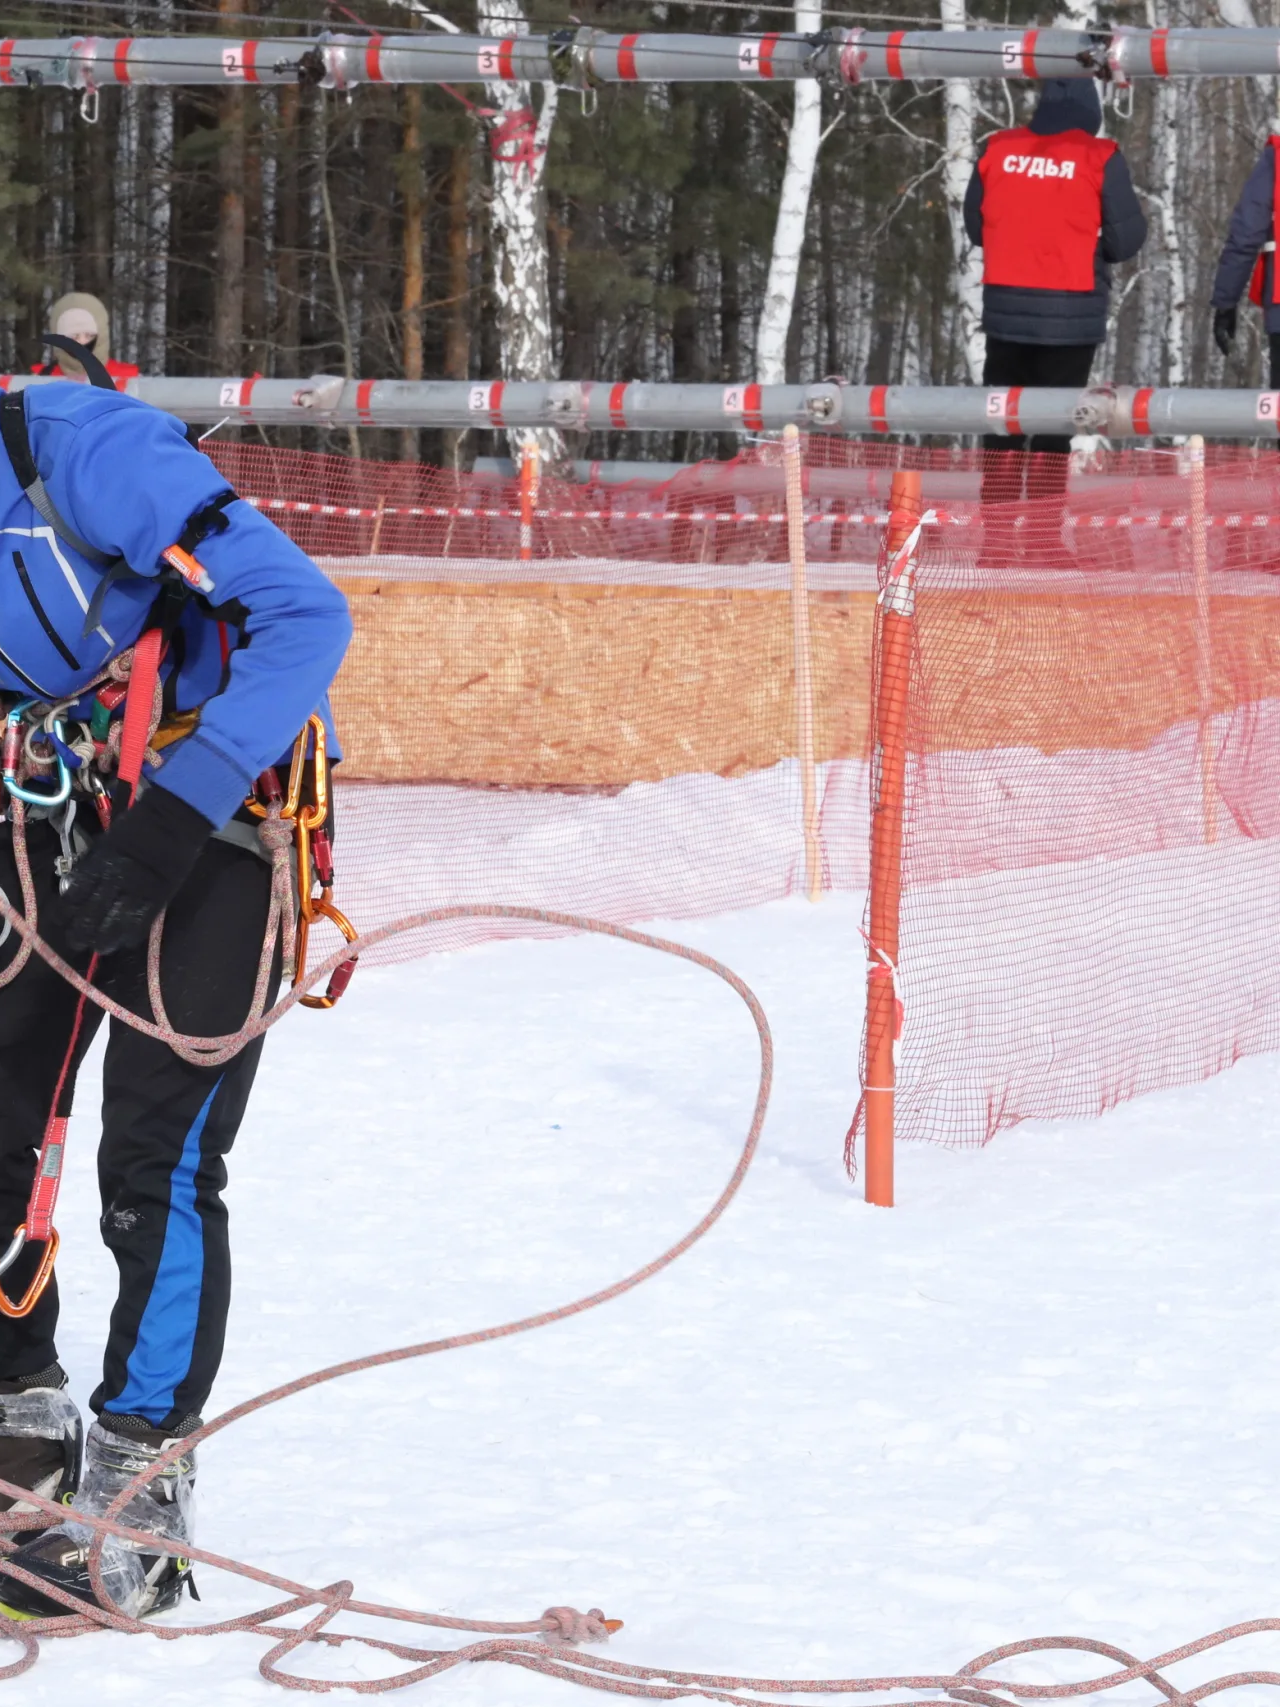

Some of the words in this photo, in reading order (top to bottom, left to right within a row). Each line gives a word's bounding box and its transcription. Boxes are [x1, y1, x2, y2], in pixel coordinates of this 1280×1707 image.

[226, 54, 238, 72] 2
[482, 51, 493, 69] 3
[742, 48, 752, 65] 4
[1004, 45, 1015, 64] 5
[1003, 154, 1075, 180] СУДЬЯ
[224, 388, 235, 405] 2
[474, 391, 485, 409] 3
[726, 391, 736, 409] 4
[989, 396, 1000, 413] 5
[1259, 397, 1271, 414] 6
[122, 1460, 179, 1474] FISER
